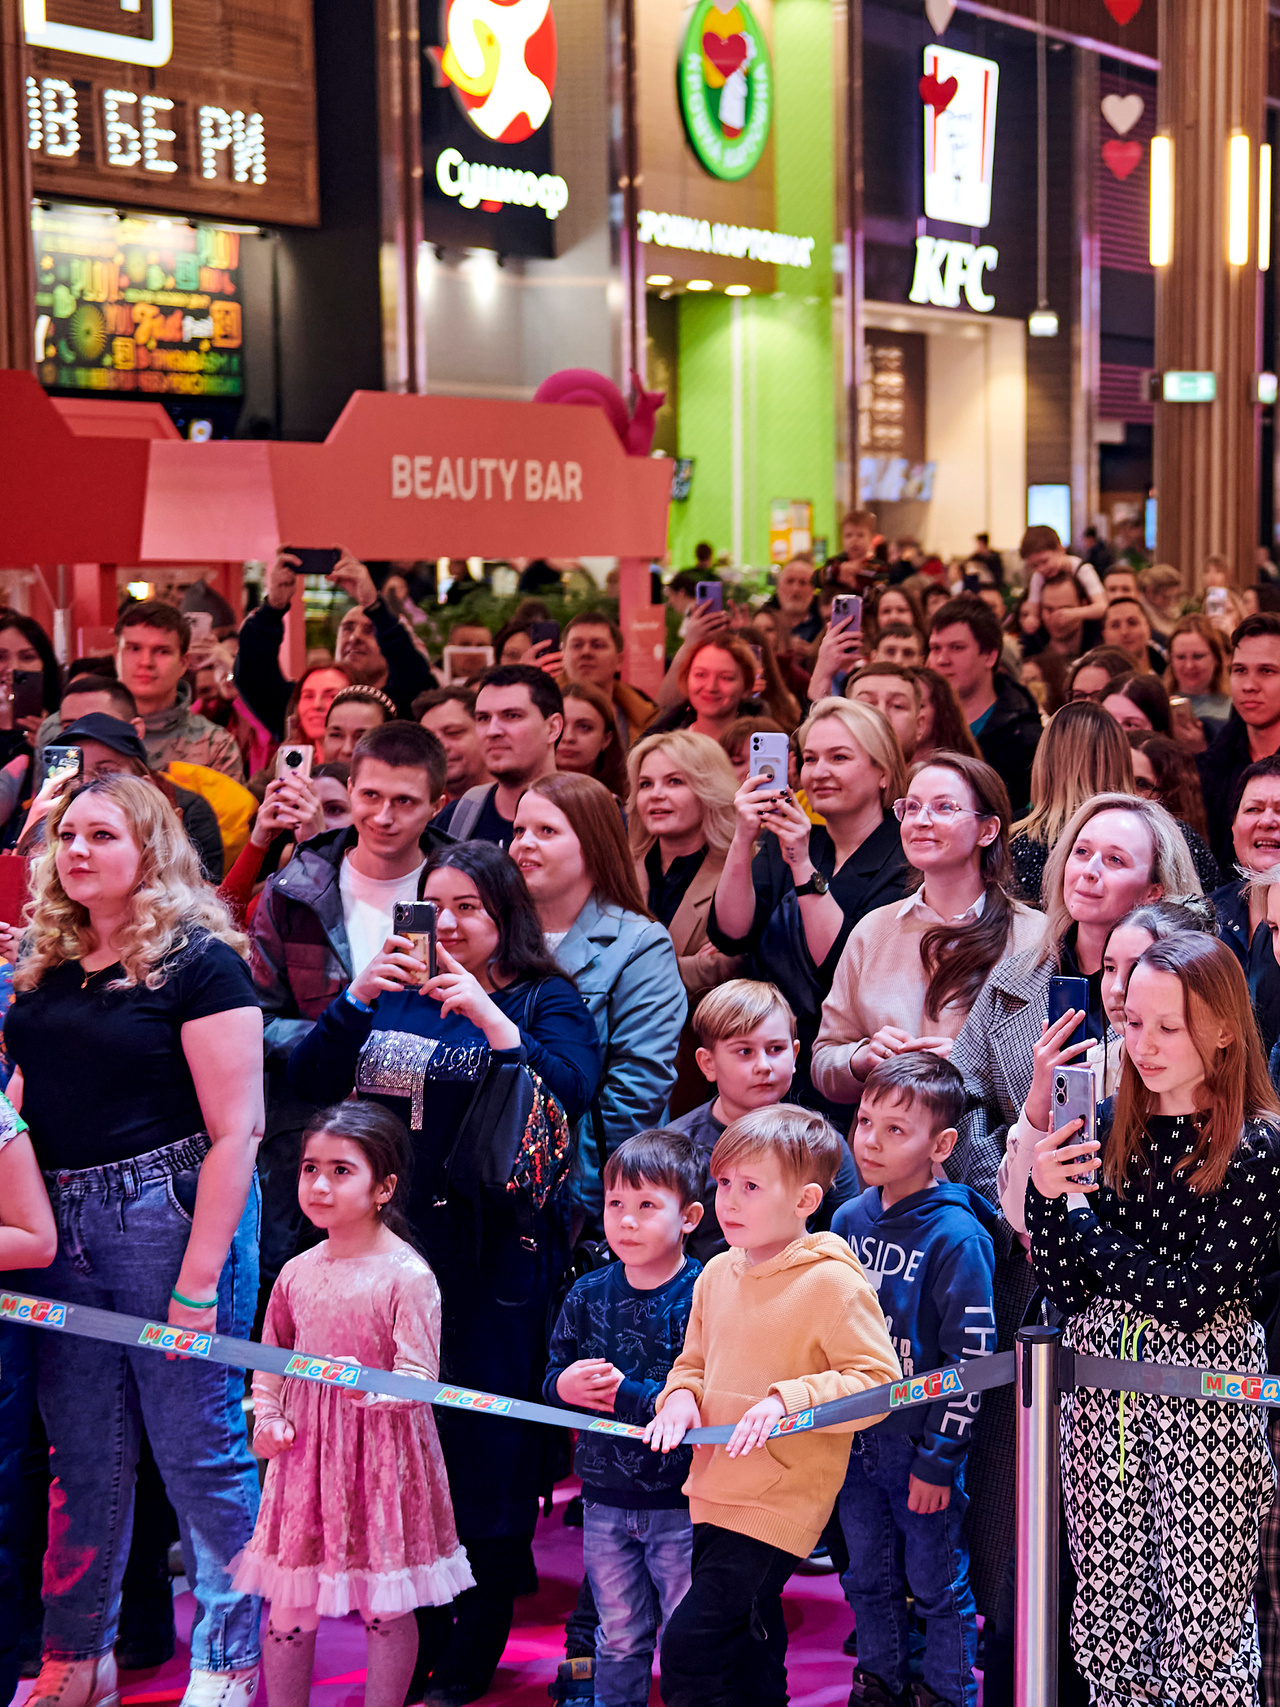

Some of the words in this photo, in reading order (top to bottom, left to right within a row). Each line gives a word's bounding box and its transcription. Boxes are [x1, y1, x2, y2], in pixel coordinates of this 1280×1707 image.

[436, 147, 569, 220] Сушкоф
[637, 209, 712, 254] РОШКА
[910, 236, 998, 312] KFC
[391, 454, 518, 501] BEAUTY
[524, 459, 583, 501] BAR
[939, 1297, 997, 1437] THRE
